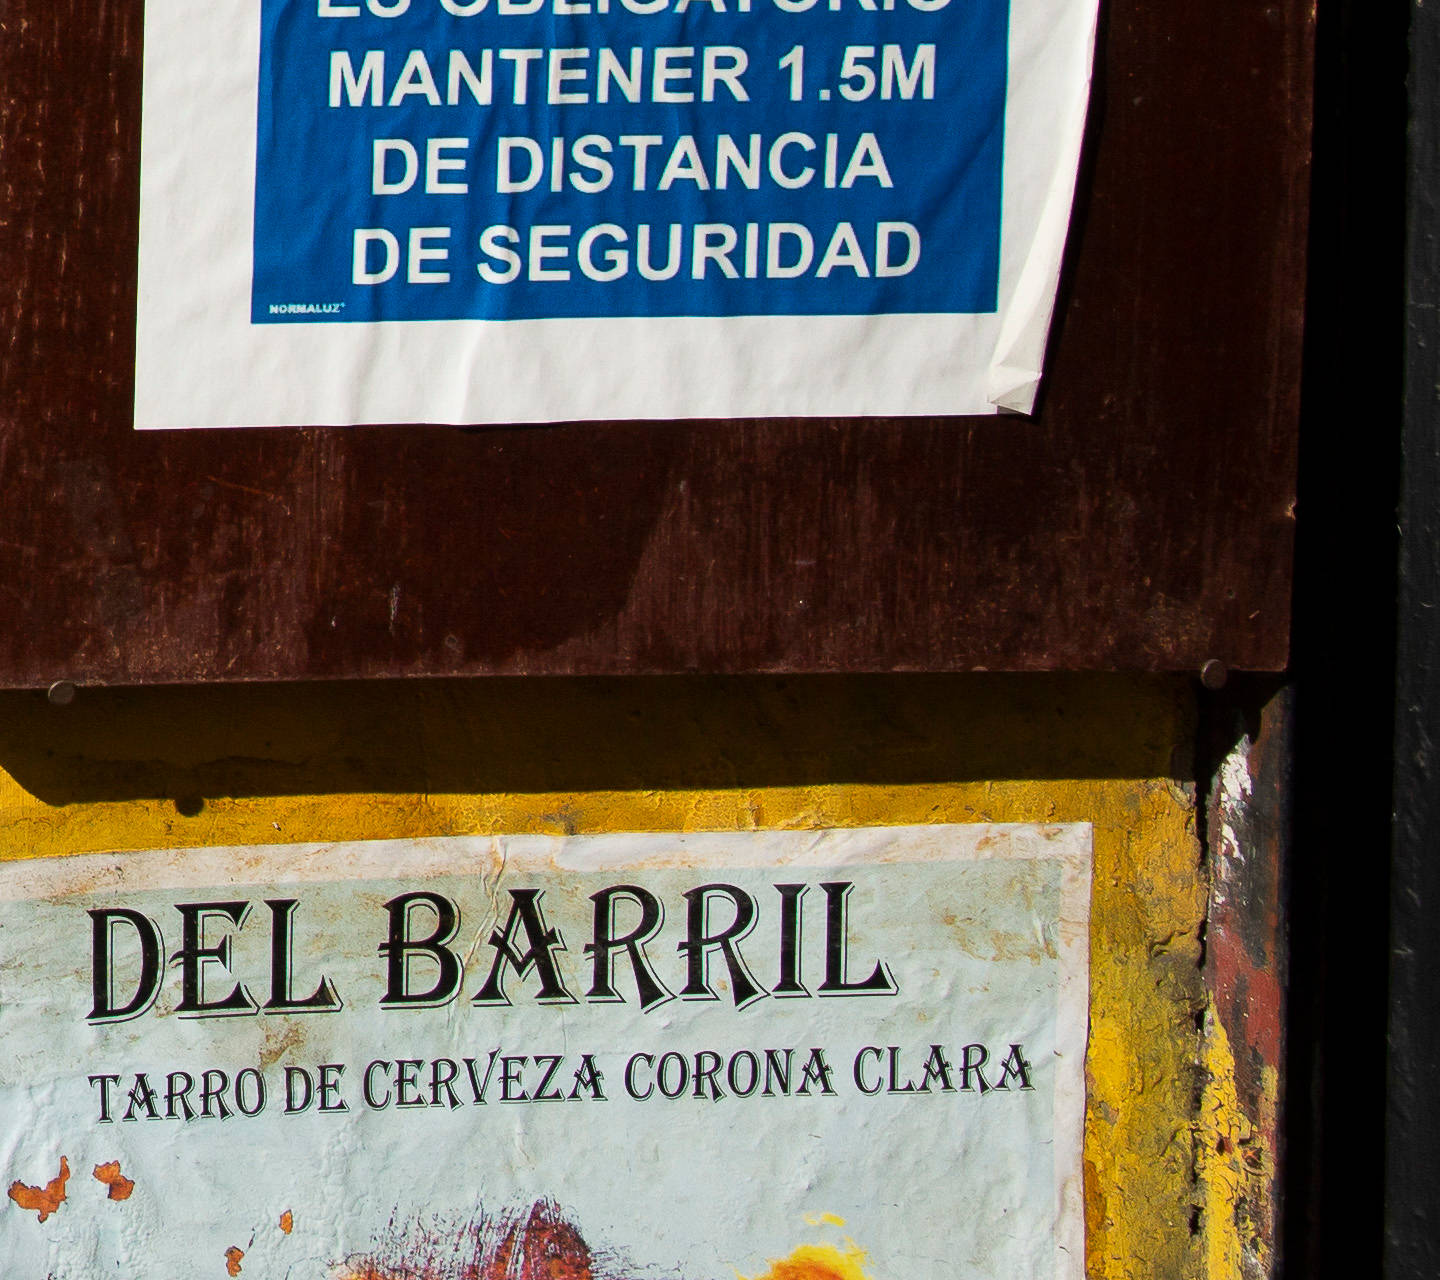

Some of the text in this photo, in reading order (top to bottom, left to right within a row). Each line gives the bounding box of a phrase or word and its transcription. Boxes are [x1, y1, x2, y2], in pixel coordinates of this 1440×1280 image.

[329, 44, 936, 108] MANTENER 1.5M
[372, 132, 893, 195] DE DISTANCIA
[352, 221, 922, 285] DE SEGURIDAD
[85, 881, 900, 1027] DEL BARRIL
[87, 1042, 1034, 1124] TARRO DE CERVEZA CORONA CLARA
